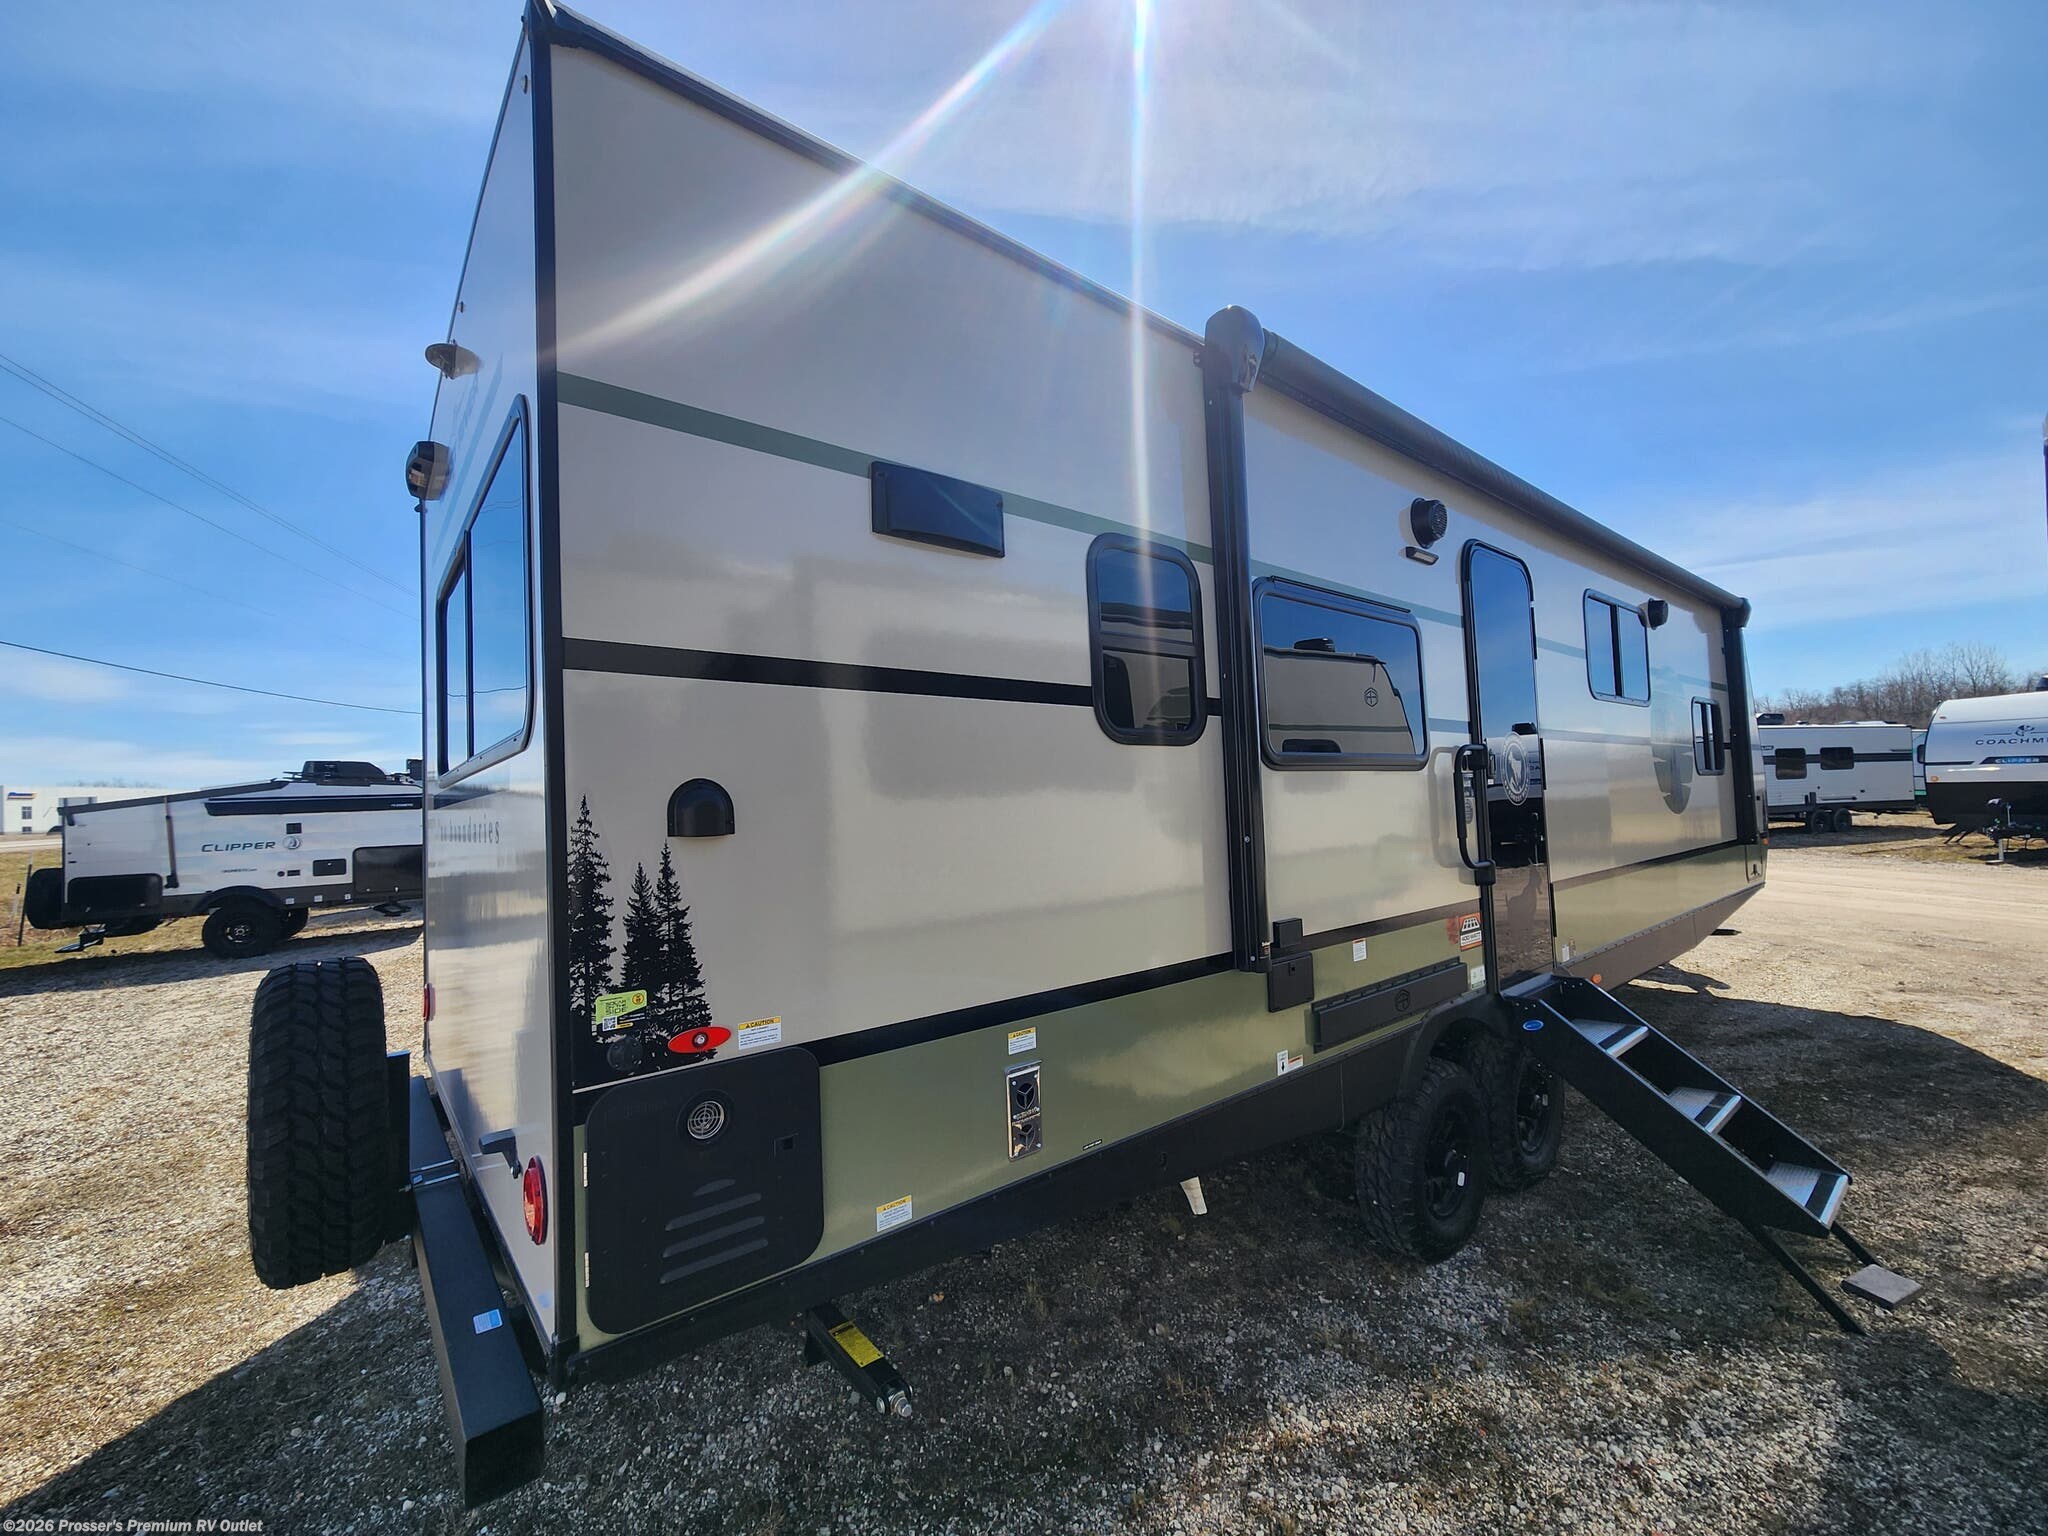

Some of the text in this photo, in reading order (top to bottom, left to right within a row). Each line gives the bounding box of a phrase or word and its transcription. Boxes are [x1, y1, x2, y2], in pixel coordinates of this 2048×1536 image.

[1975, 737, 2048, 746] COACHM
[201, 841, 276, 853] CLIPPER
[751, 1019, 775, 1028] CAUTION
